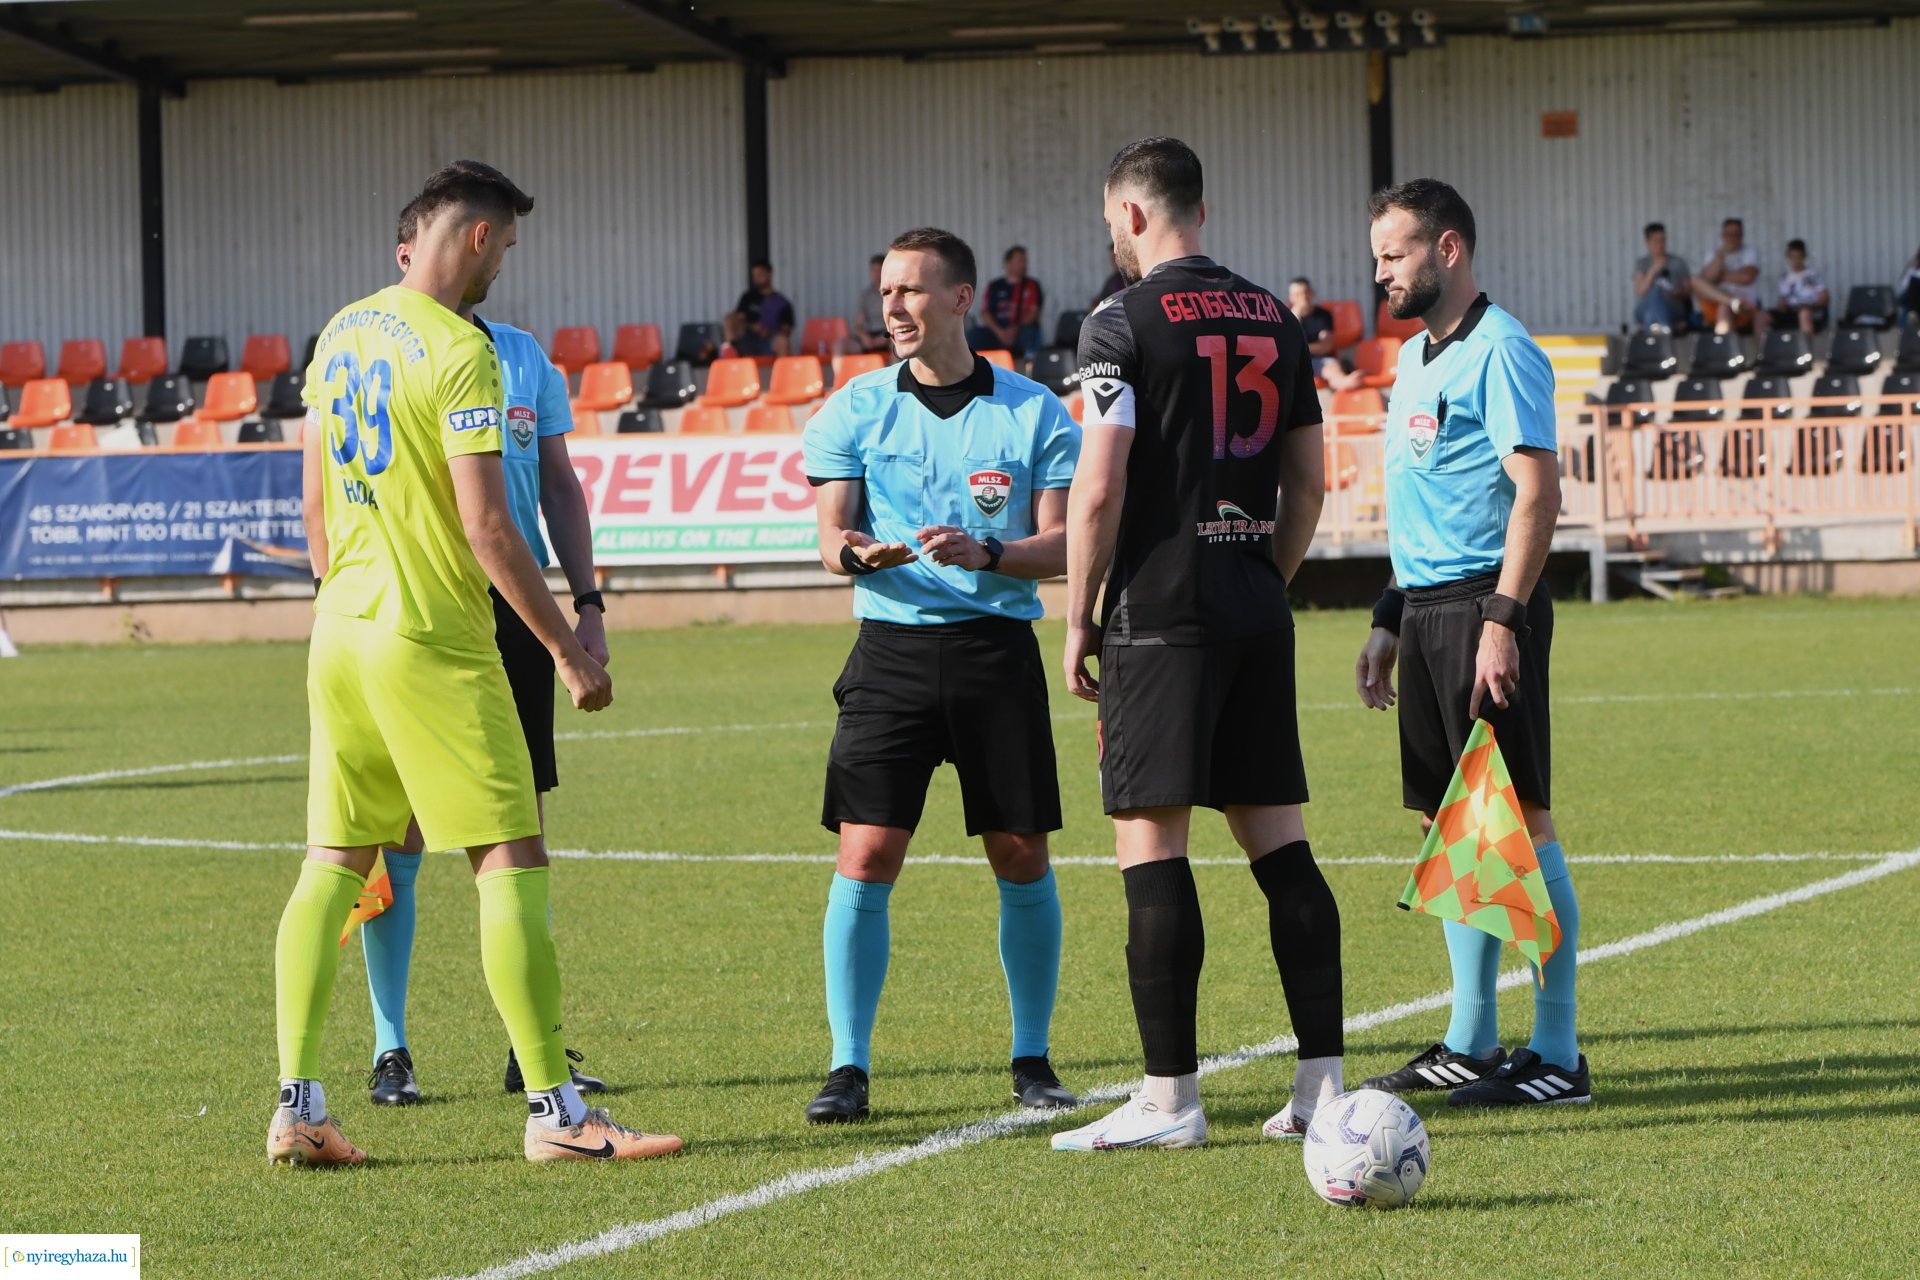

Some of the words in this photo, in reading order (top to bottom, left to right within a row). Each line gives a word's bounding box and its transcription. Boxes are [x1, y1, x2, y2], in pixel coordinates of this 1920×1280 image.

[378, 313, 397, 333] FC
[1196, 335, 1280, 460] 13
[324, 351, 393, 476] 39
[977, 475, 1003, 485] MLSZ
[204, 496, 303, 519] SZAKTERÜ
[134, 521, 168, 543] 100
